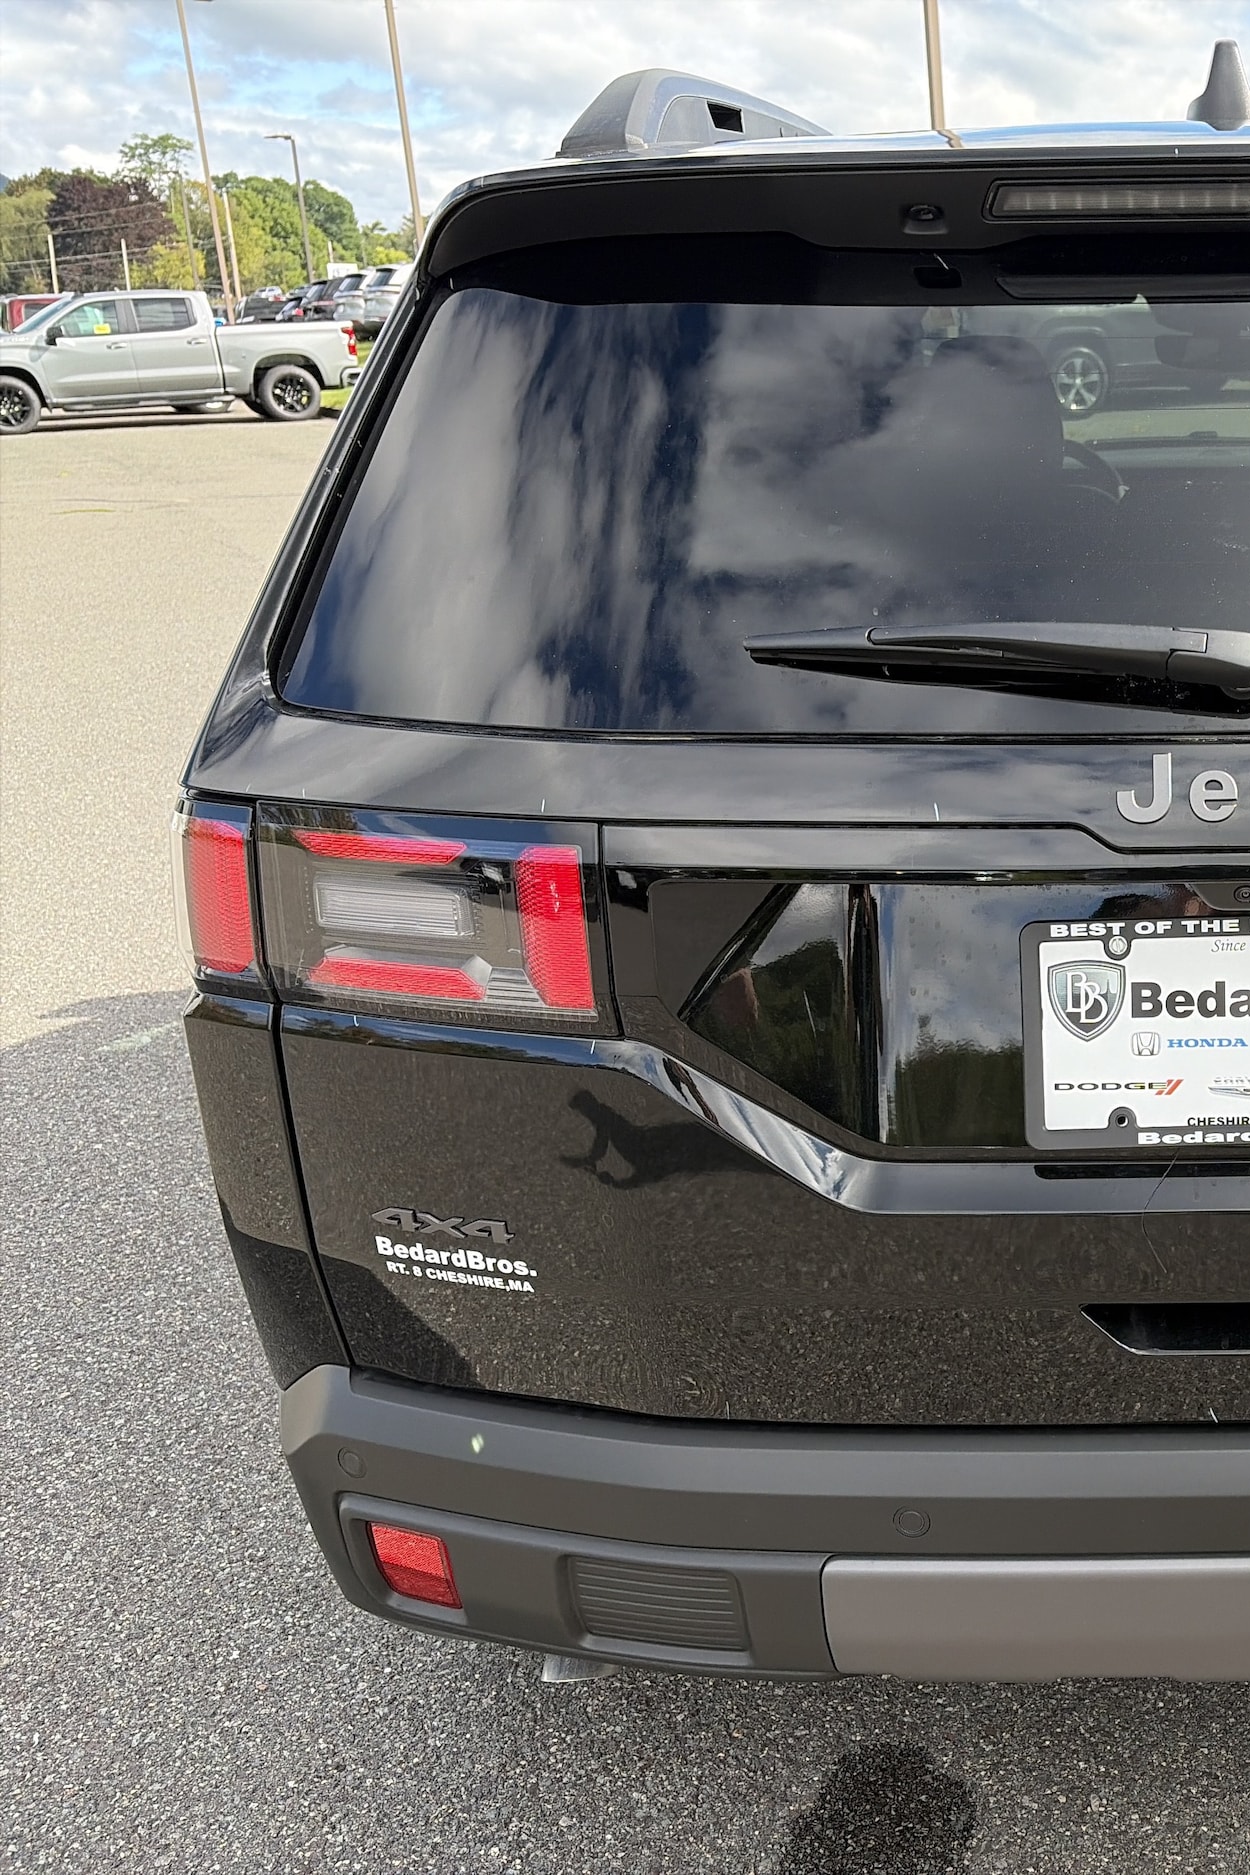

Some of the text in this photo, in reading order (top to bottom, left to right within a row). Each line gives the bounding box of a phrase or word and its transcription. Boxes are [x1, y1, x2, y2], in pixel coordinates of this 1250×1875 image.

[1050, 922, 1126, 938] BEST
[1134, 921, 1173, 935] OF
[1181, 919, 1240, 934] THE
[1211, 939, 1246, 953] Since
[1167, 1038, 1249, 1048] HONDA
[1054, 1082, 1168, 1091] DODGE
[375, 1236, 538, 1276] BedardBros.
[386, 1260, 411, 1275] RT.
[412, 1266, 424, 1278] 8
